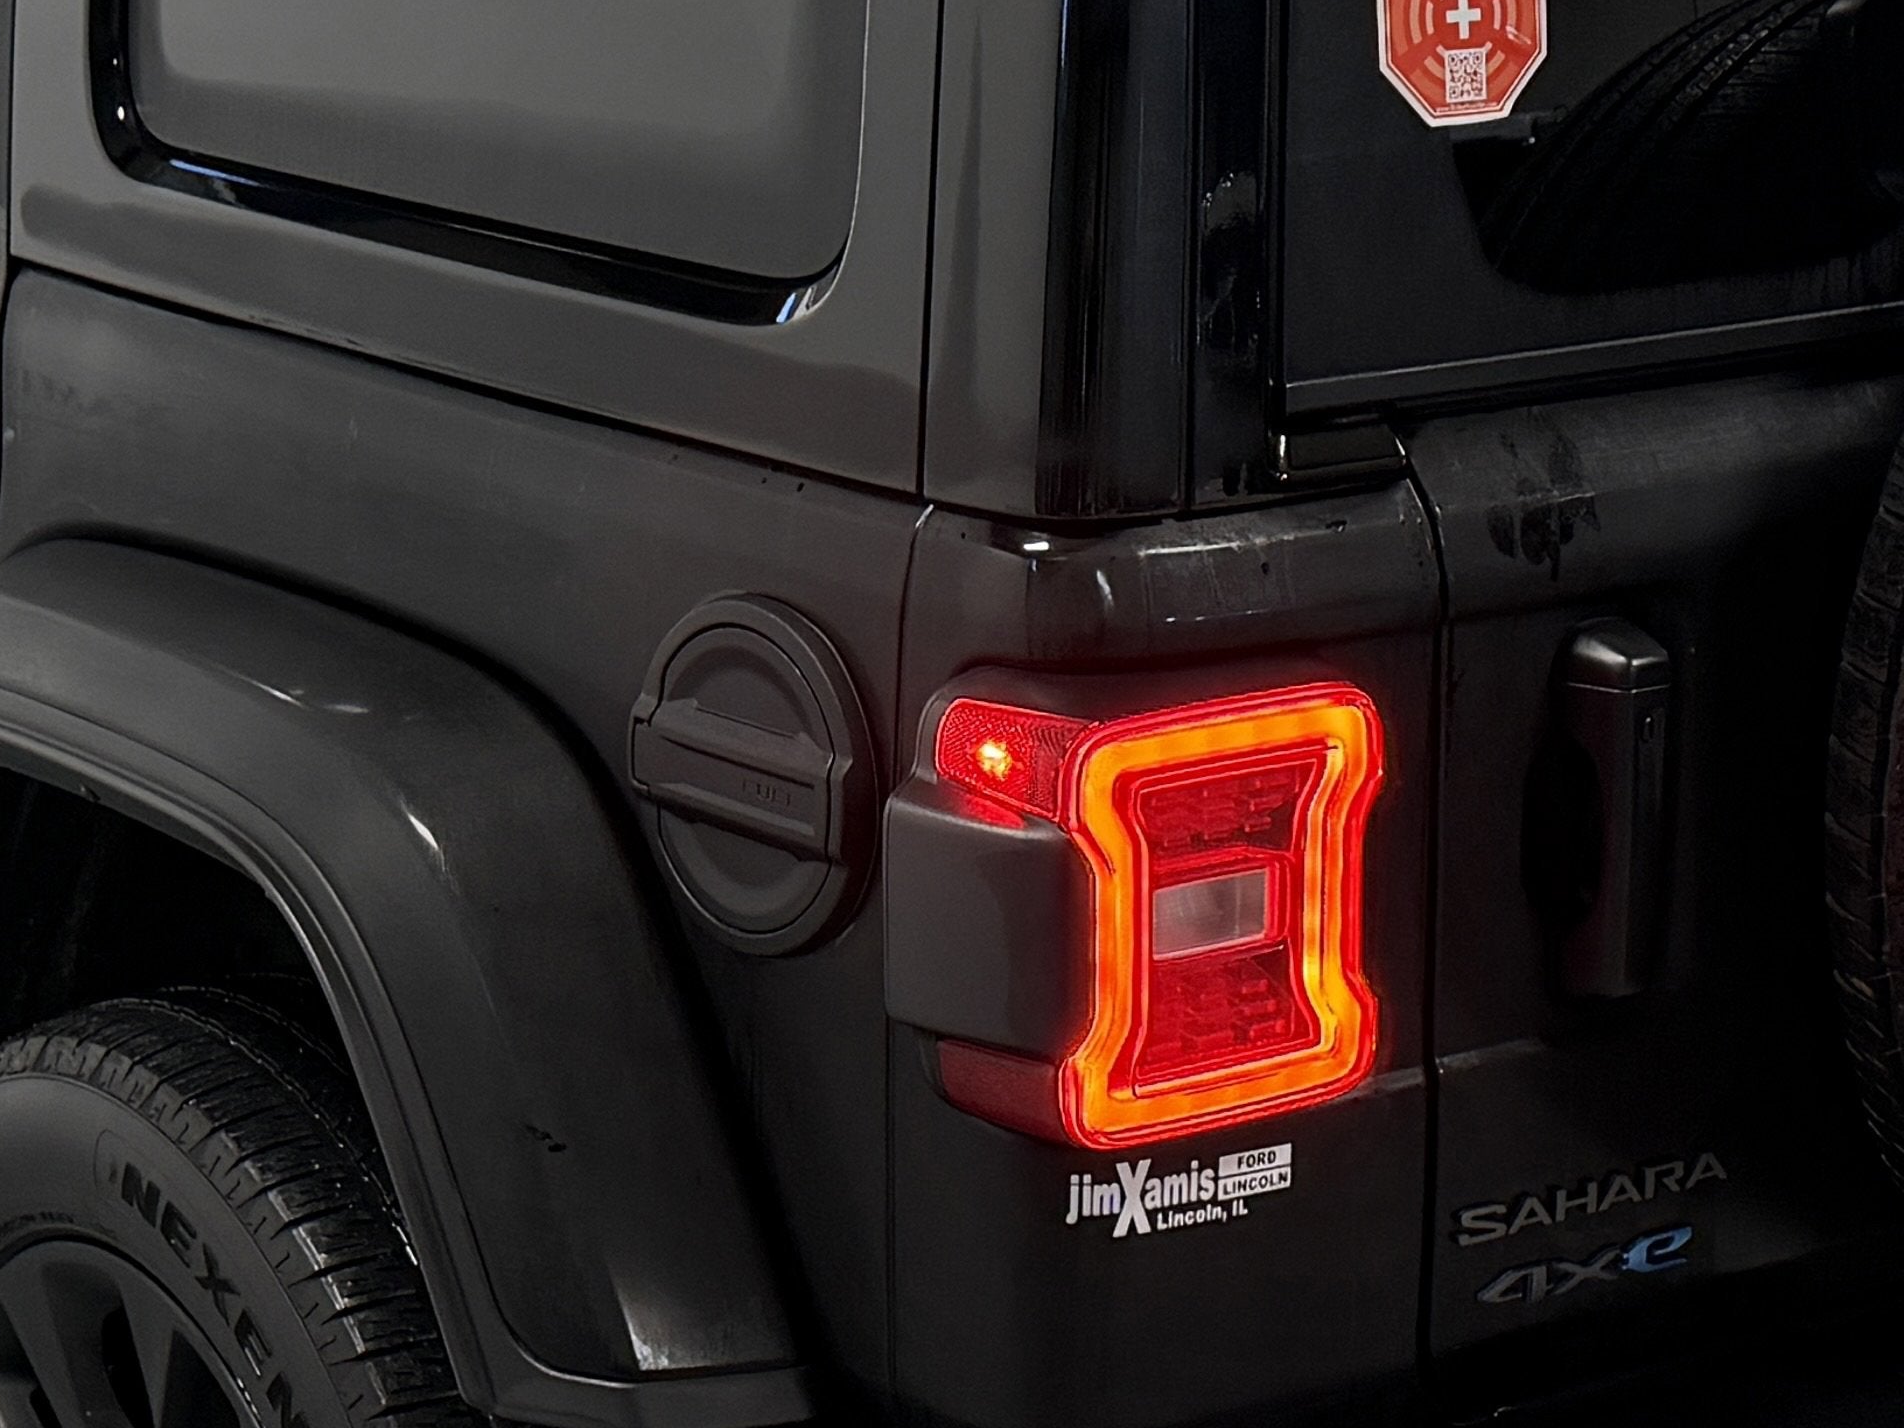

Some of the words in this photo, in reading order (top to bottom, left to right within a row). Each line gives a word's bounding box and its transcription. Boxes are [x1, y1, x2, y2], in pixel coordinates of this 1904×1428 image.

[1236, 1150, 1277, 1170] FORD
[1223, 1170, 1289, 1198] LINCOLN
[1456, 1152, 1728, 1247] SAHARA
[1156, 1203, 1228, 1231] Lincoln,
[1232, 1199, 1248, 1217] IL
